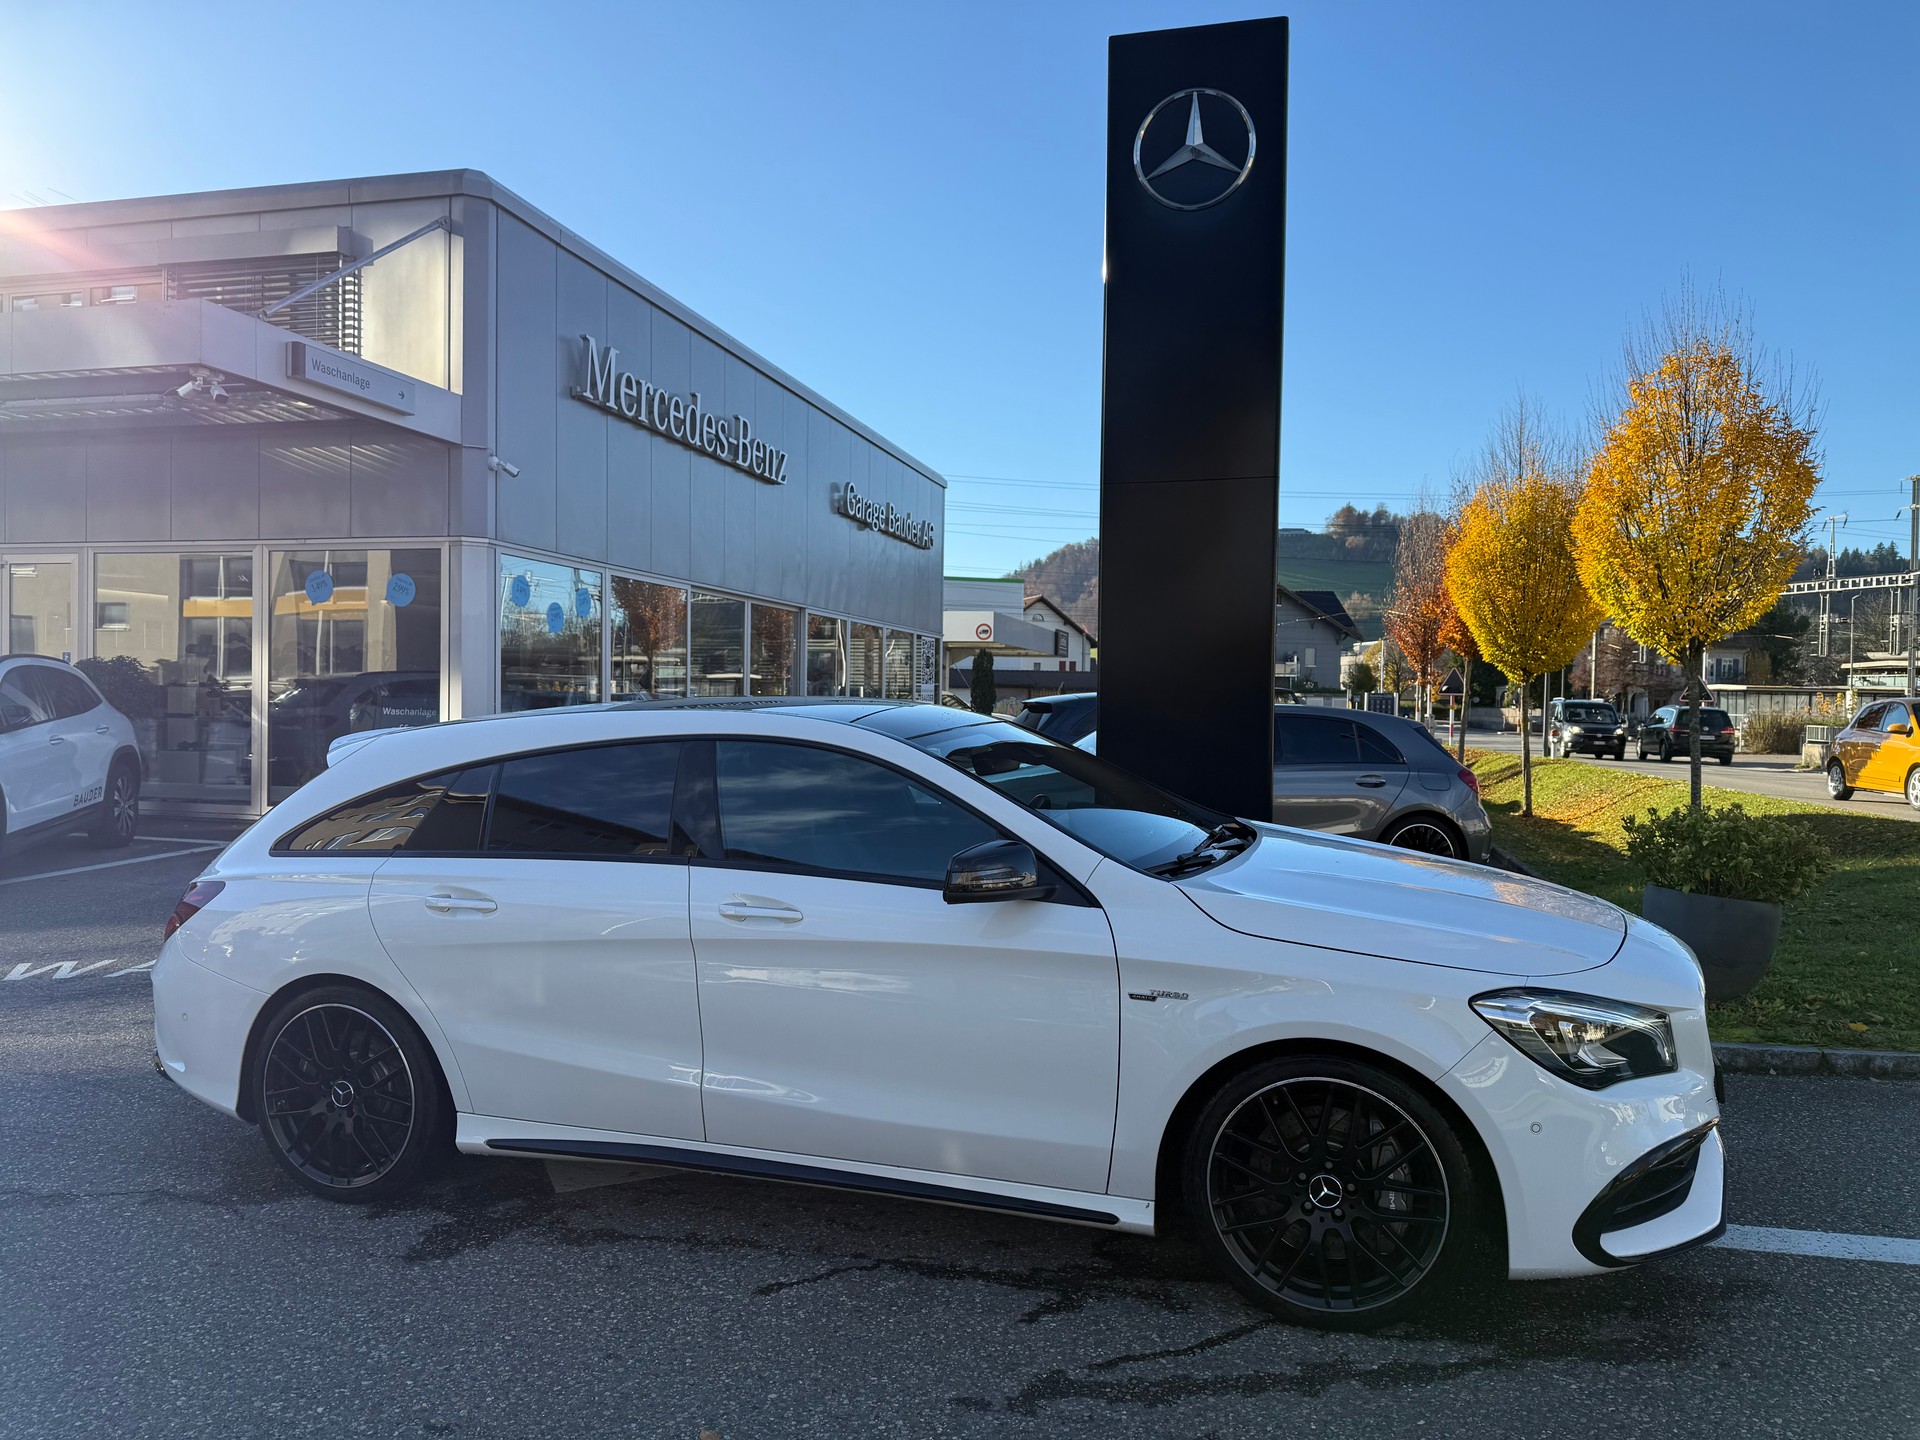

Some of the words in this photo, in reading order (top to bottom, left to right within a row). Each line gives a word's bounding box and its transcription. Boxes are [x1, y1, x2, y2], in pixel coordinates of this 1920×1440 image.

[311, 358, 371, 390] Waschanlage
[579, 333, 789, 485] Mercedes-Benz
[844, 481, 886, 532] Garage
[886, 501, 921, 543] Bauder
[922, 519, 935, 550] AG
[382, 706, 437, 718] Waschanlage
[73, 786, 103, 807] BAUDER
[1150, 989, 1189, 1000] TURBO
